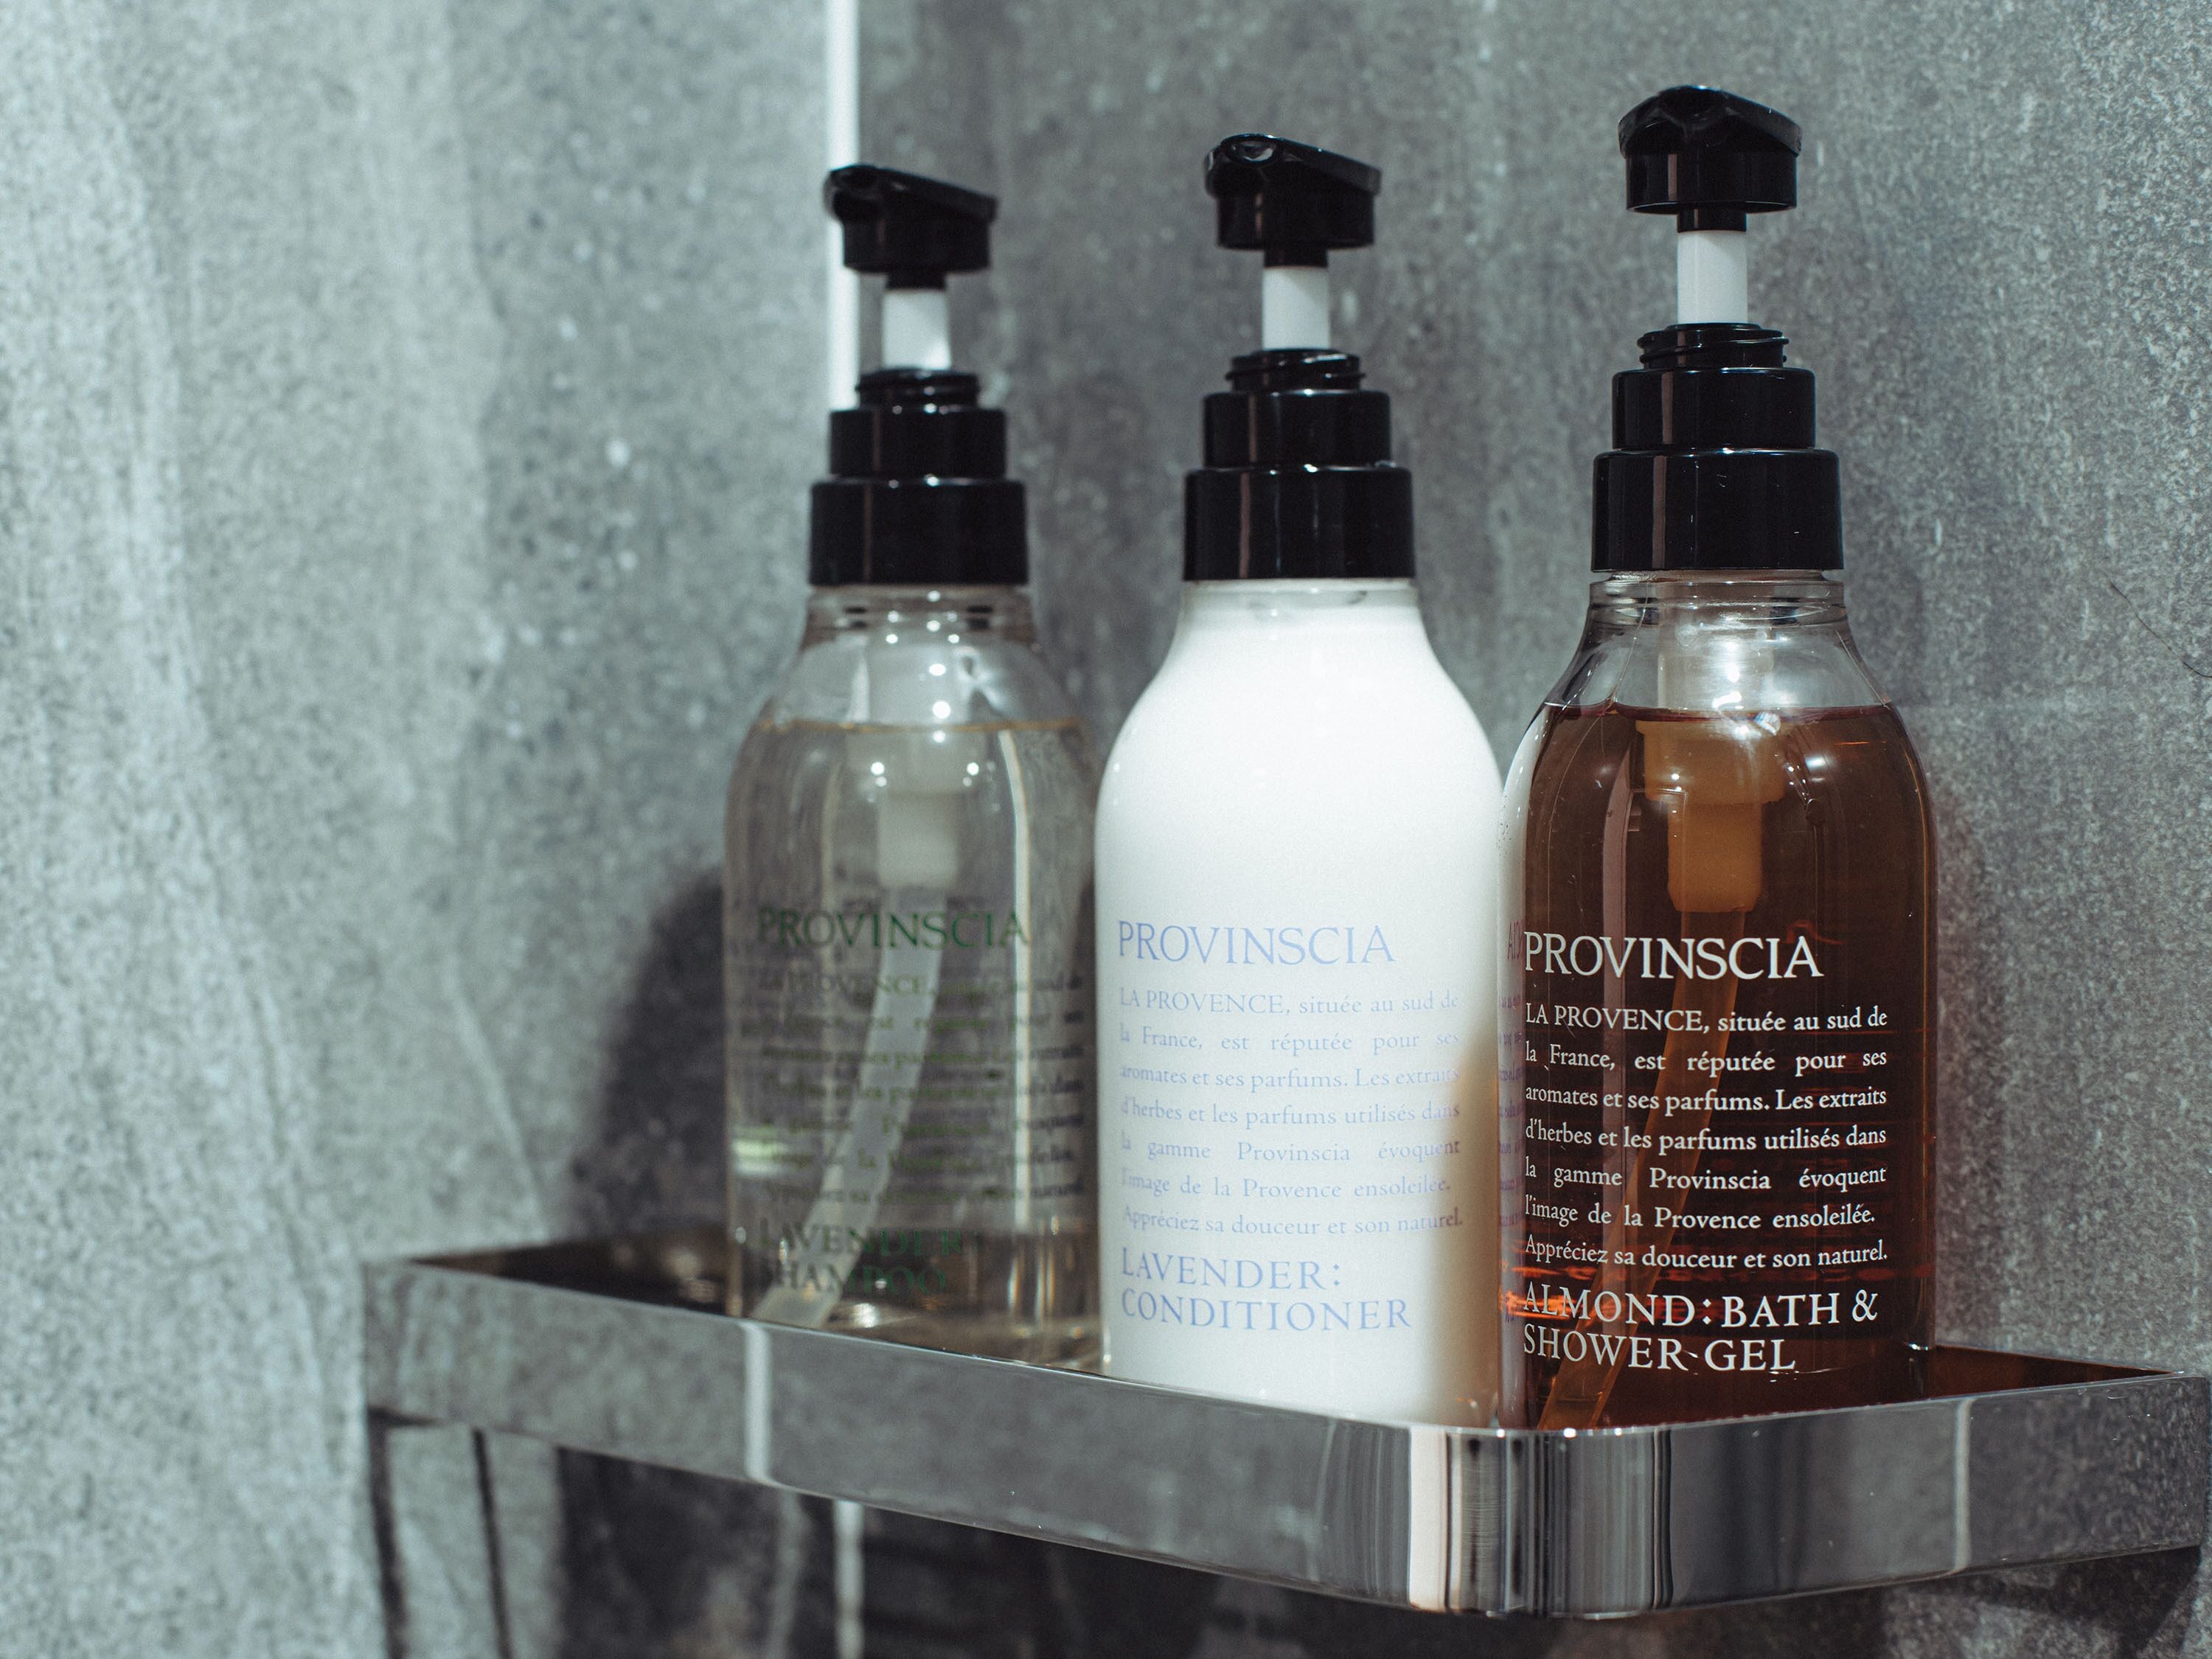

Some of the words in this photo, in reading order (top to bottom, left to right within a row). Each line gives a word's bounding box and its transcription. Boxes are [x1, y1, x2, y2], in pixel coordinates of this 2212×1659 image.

[1118, 919, 1397, 966] PROVINSCIA
[1523, 931, 1824, 981] PROVINSCIA
[1119, 987, 1141, 1009] LA
[1146, 989, 1291, 1017] PROVENCE,
[1298, 994, 1363, 1015] située
[1370, 997, 1394, 1013] au
[1402, 990, 1436, 1011] sud
[1439, 990, 1458, 1009] de
[1526, 1003, 1549, 1026] LA
[1554, 1006, 1710, 1034] PROVENCE,
[1717, 1012, 1787, 1033] située
[1792, 1015, 1820, 1032] au
[1826, 1008, 1862, 1029] sud
[1866, 1006, 1888, 1026] de
[1141, 1026, 1203, 1050] France,
[1220, 1034, 1250, 1051] est
[1270, 1032, 1352, 1056] réputée
[1372, 1032, 1419, 1054] pour
[1436, 1032, 1458, 1046] ses
[1525, 1042, 1537, 1062] la
[1549, 1043, 1616, 1071] France,
[1634, 1052, 1666, 1071] est
[1687, 1051, 1776, 1077] réputée
[1795, 1054, 1846, 1077] pour
[1862, 1051, 1888, 1067] ses
[1192, 1069, 1209, 1085] et
[1214, 1071, 1245, 1088] ses
[1251, 1068, 1348, 1093] parfums.
[1354, 1068, 1390, 1088] Les
[1187, 1105, 1206, 1122] et
[1211, 1103, 1239, 1124] les
[1245, 1104, 1337, 1130] parfums
[1344, 1103, 1416, 1125] utilisés
[1421, 1102, 1460, 1119] dans
[1525, 1084, 1599, 1107] aromates
[1602, 1092, 1624, 1108] et
[1627, 1093, 1660, 1110] ses
[1665, 1091, 1770, 1116] parfums.
[1775, 1089, 1814, 1110] Les
[1818, 1086, 1887, 1107] extraits
[1147, 1141, 1211, 1162] gamme
[1237, 1141, 1351, 1163] Provinscia
[1377, 1140, 1460, 1163] évoquent
[1525, 1119, 1593, 1145] d'herbes
[1597, 1130, 1618, 1147] et
[1624, 1127, 1652, 1150] les
[1658, 1129, 1757, 1155] parfums
[1764, 1127, 1840, 1150] utilisés
[1846, 1124, 1887, 1146] dans
[1180, 1175, 1201, 1194] de
[1214, 1177, 1231, 1197] la
[1242, 1178, 1342, 1199] Provence
[1525, 1157, 1537, 1178] la
[1554, 1165, 1623, 1188] gamme
[1649, 1167, 1772, 1190] Provinscia
[1798, 1166, 1887, 1192] évoquent
[1204, 1217, 1225, 1233] sa
[1231, 1214, 1321, 1235] douceur
[1327, 1218, 1347, 1235] et
[1354, 1217, 1390, 1234] son
[1397, 1208, 1463, 1231] naturel.
[1525, 1194, 1579, 1226] l'image
[1587, 1202, 1613, 1224] de
[1624, 1203, 1643, 1227] la
[1654, 1206, 1762, 1229] Provence
[1772, 1203, 1877, 1228] ensoleilée.
[1524, 1234, 1609, 1264] Appréciez
[1614, 1248, 1636, 1265] sa
[1641, 1246, 1738, 1269] douceur
[1743, 1251, 1767, 1269] et
[1772, 1250, 1812, 1267] son
[1817, 1239, 1888, 1265] naturel.
[1121, 1247, 1341, 1291] LAVENDER:
[1121, 1287, 1411, 1332] CONDITIONER
[1851, 1289, 1879, 1322] &
[1523, 1323, 1688, 1371] SHOWER
[1704, 1338, 1797, 1372] GEL
